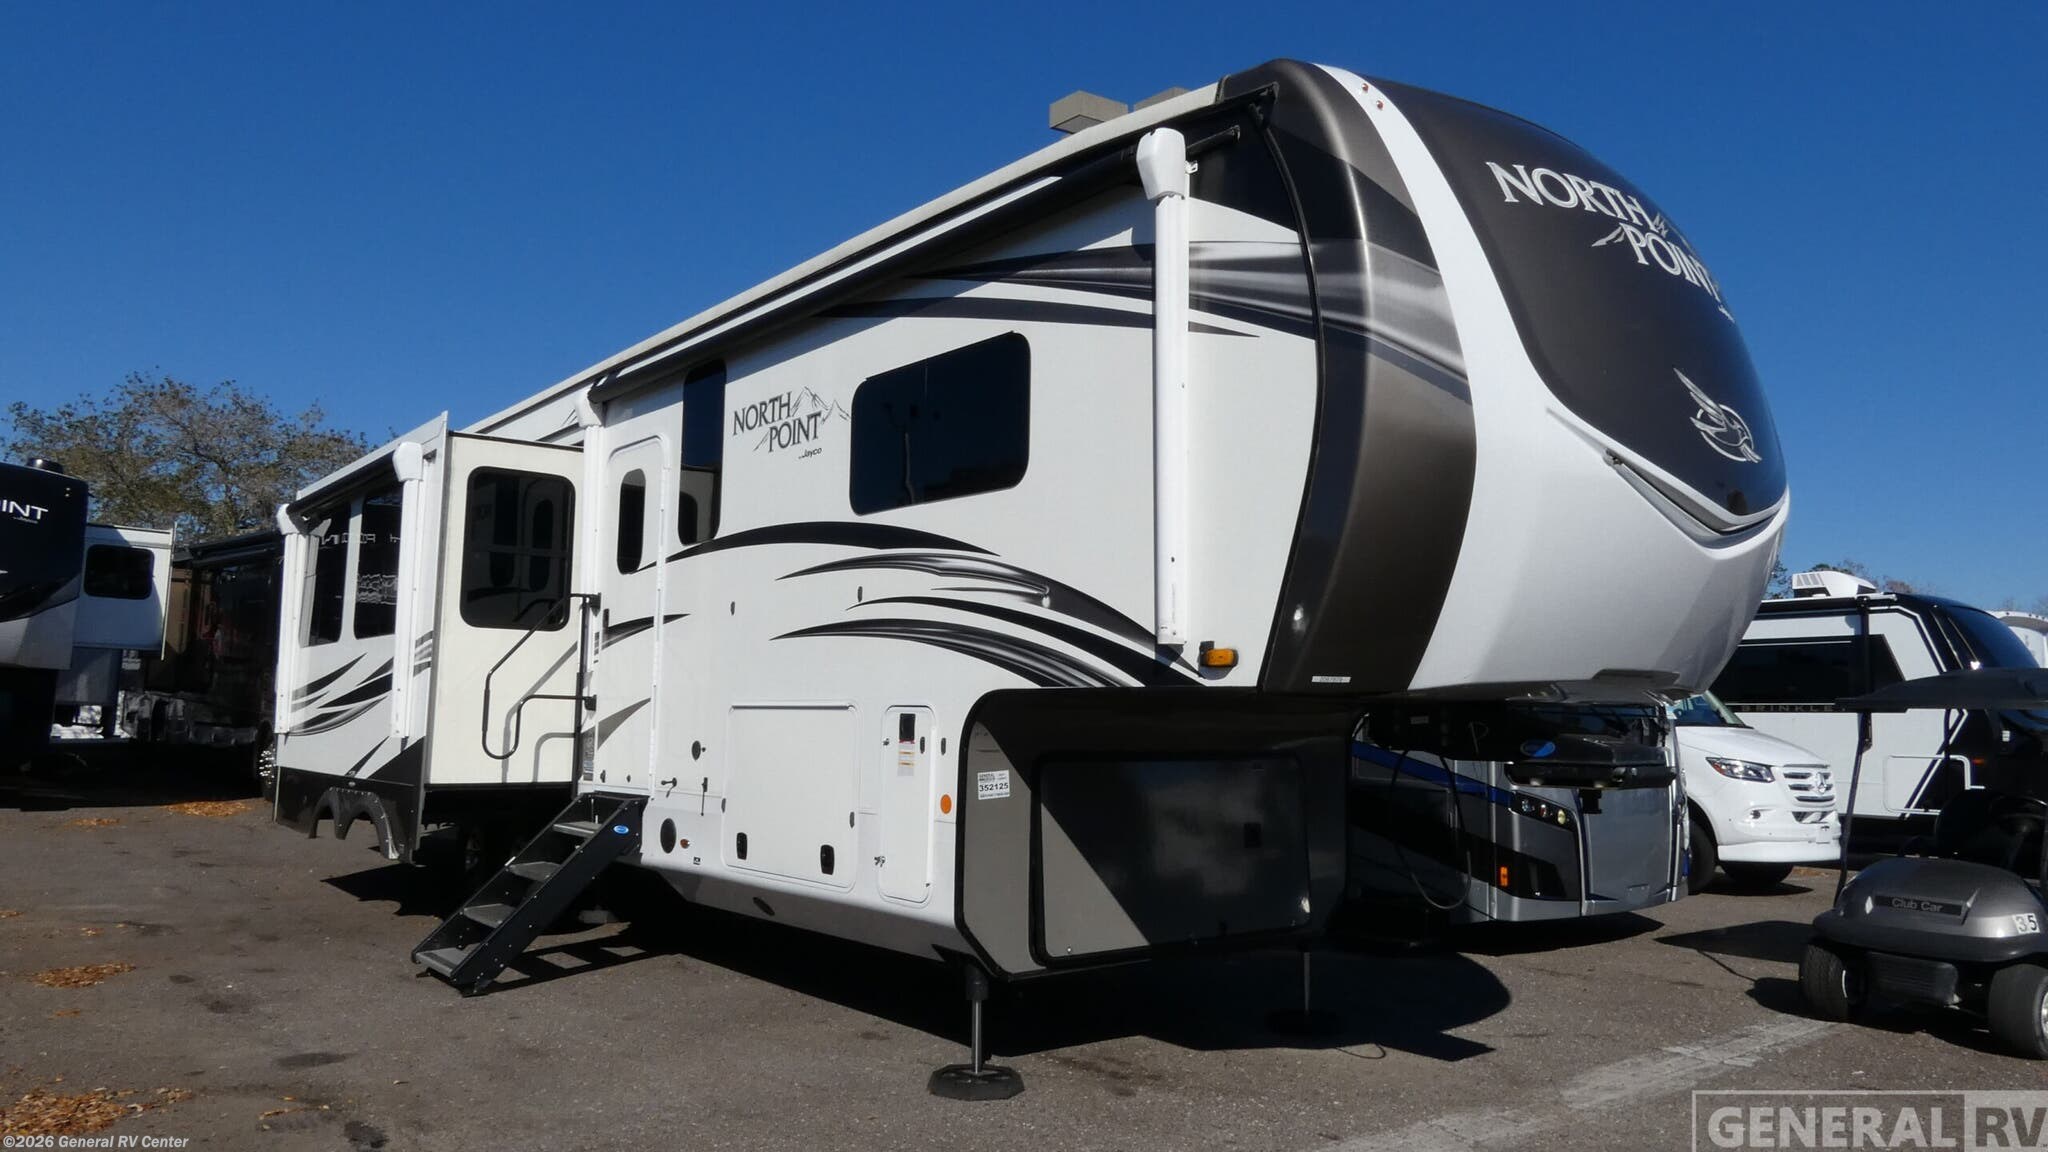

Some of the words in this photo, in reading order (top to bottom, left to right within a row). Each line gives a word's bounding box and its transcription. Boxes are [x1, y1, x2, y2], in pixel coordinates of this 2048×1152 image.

[1485, 161, 1659, 233] NORTH
[1619, 222, 1721, 303] POINT
[733, 391, 793, 436] NORTH
[768, 411, 822, 453] POINT
[0, 499, 49, 520] INT
[1741, 704, 1846, 712] BRINKLE
[979, 783, 1009, 792] 352125
[1891, 897, 1918, 911] Club
[1920, 901, 1944, 912] Car
[2015, 915, 2038, 932] 35
